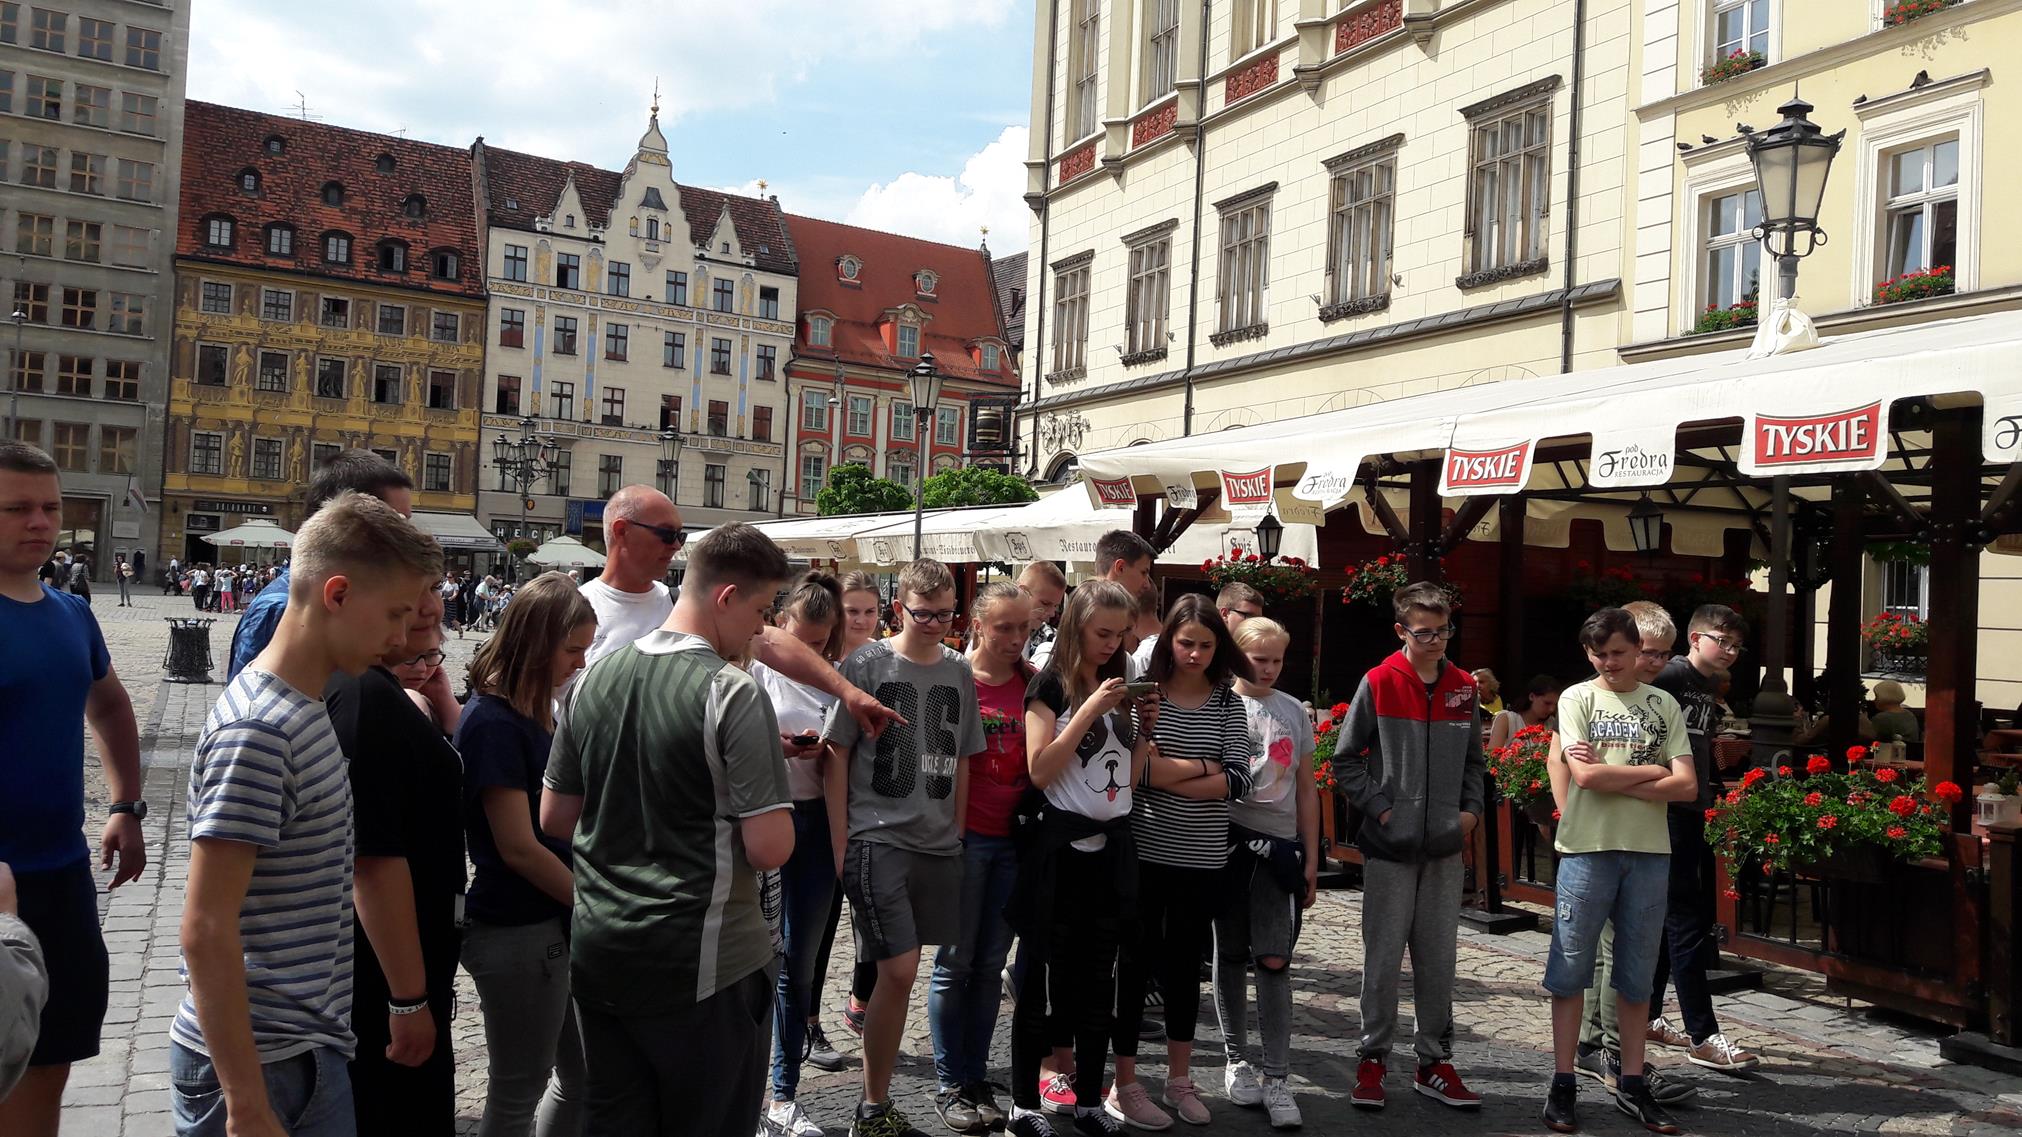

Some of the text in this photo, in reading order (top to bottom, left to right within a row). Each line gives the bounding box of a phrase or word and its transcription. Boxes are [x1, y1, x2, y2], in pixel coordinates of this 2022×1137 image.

[1762, 414, 1869, 457] TYSKIE
[1451, 450, 1521, 481] TYSKIE
[1599, 448, 1667, 478] Fredra
[1614, 468, 1664, 478] RESTAURACJA
[1096, 482, 1134, 500] TYSKIE
[1226, 475, 1268, 498] TYSKIE
[1302, 474, 1347, 494] Fredra
